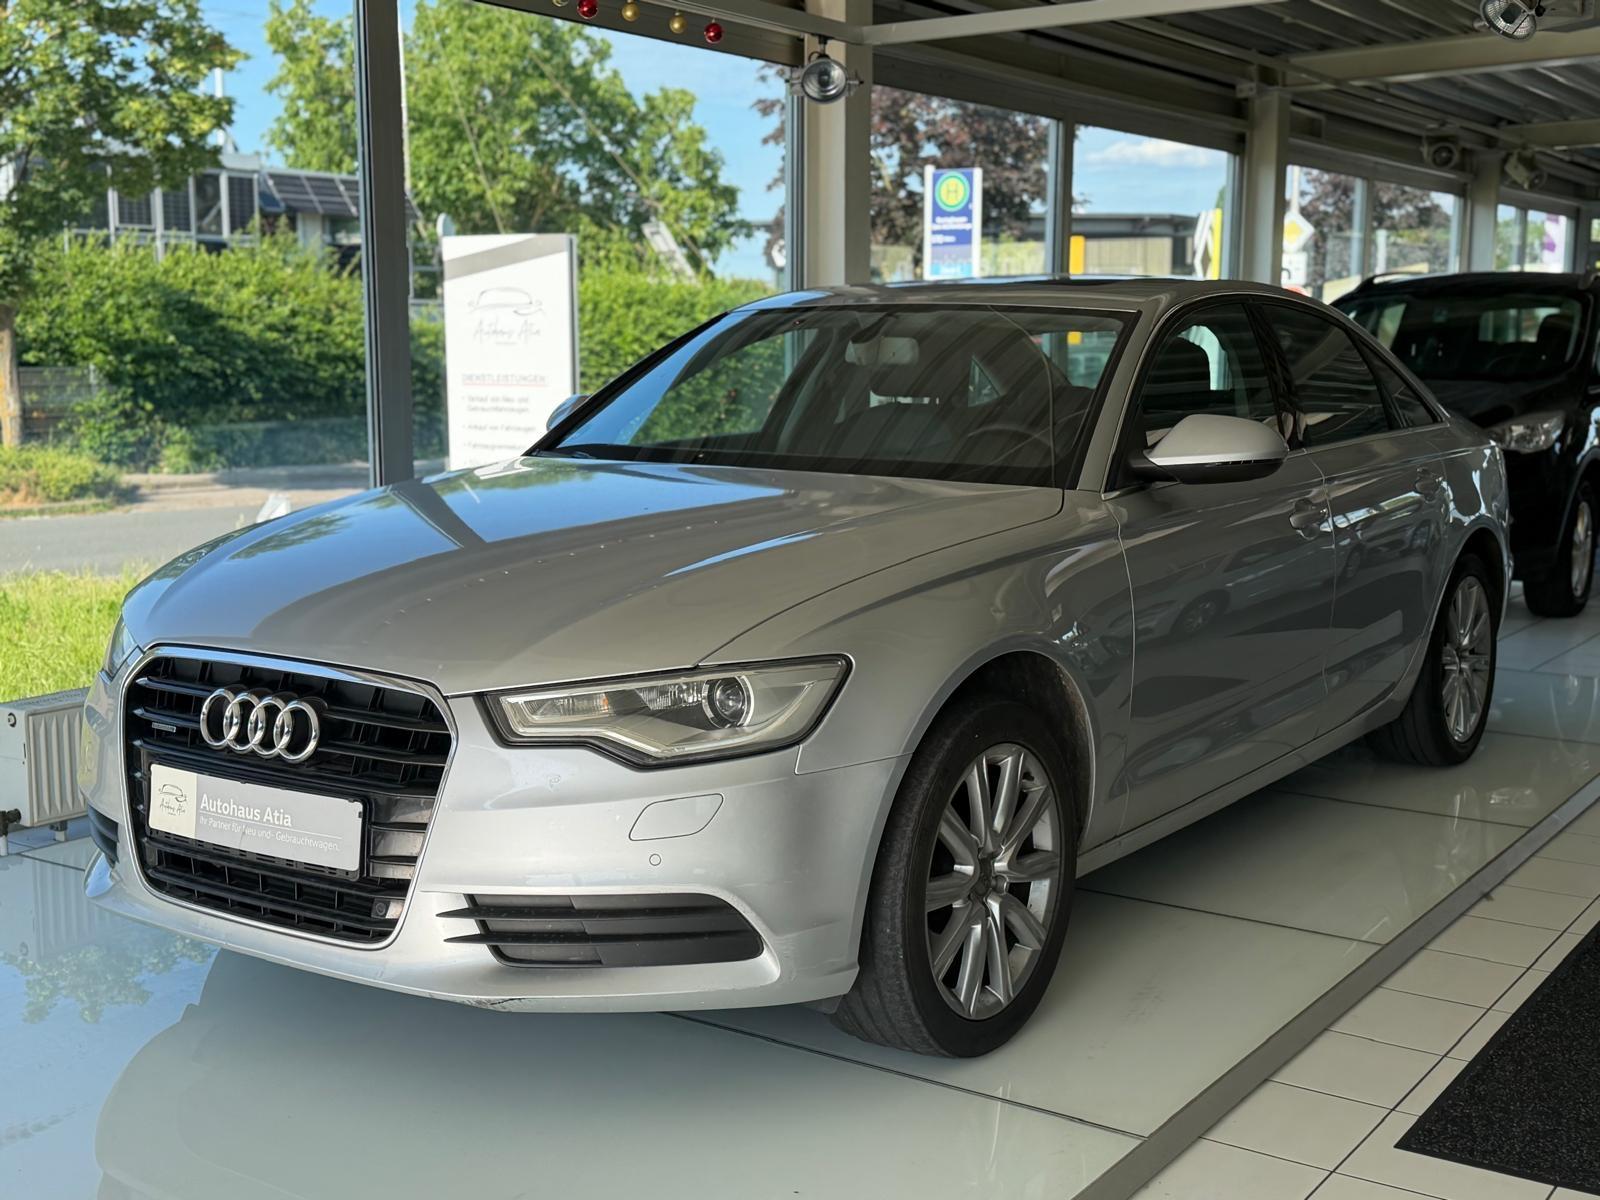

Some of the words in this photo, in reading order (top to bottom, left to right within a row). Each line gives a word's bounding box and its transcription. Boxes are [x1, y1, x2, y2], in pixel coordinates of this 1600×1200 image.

[200, 793, 261, 821] Autohaus
[263, 807, 292, 827] Atia
[199, 815, 209, 826] Ihr
[208, 818, 232, 832] Partner
[231, 821, 242, 834] für
